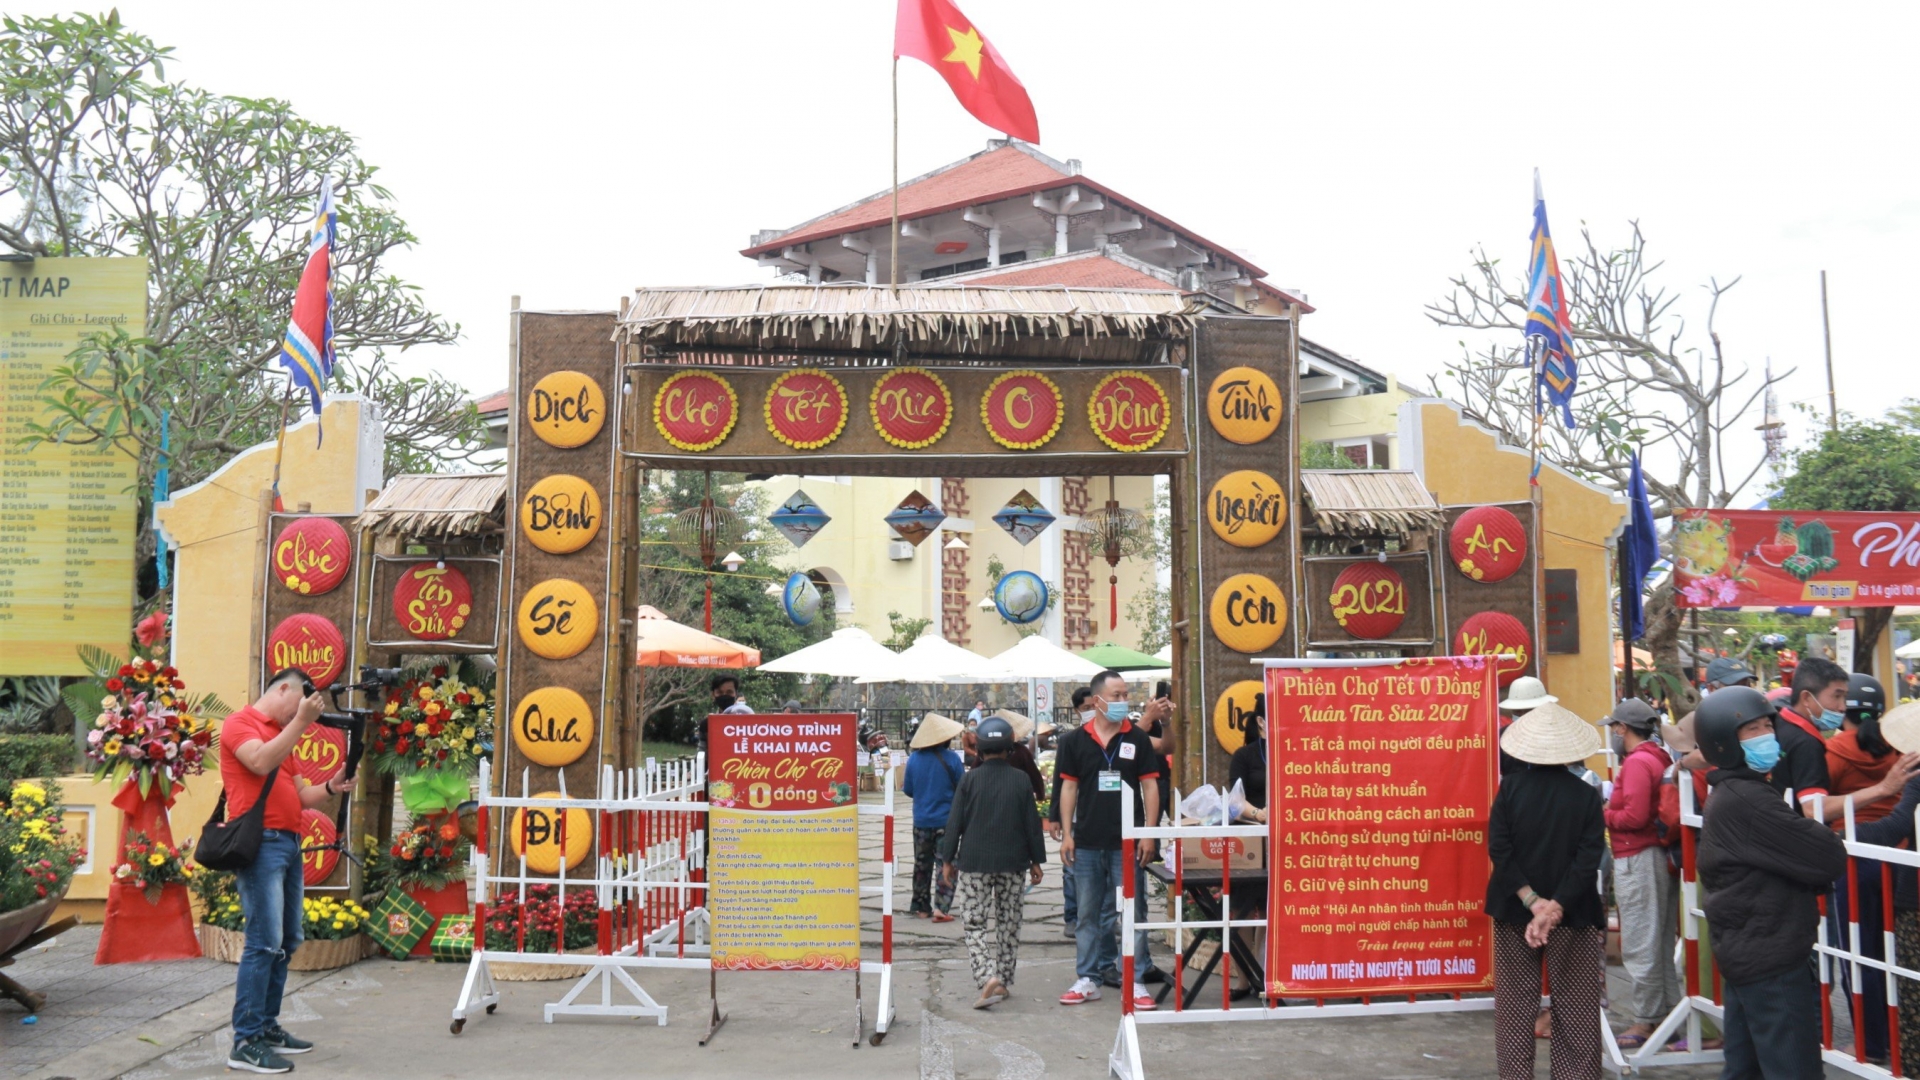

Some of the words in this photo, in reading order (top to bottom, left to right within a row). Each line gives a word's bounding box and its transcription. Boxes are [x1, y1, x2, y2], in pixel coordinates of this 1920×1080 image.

[20, 278, 70, 297] MAP
[31, 314, 49, 324] Ghi
[1338, 579, 1405, 615] 2021
[1832, 586, 1850, 598] gian
[1870, 586, 1883, 595] 14
[1902, 585, 1914, 595] 00
[1282, 676, 1336, 695] Phiên
[1343, 676, 1379, 701] Chợ
[1383, 674, 1415, 695] Tết
[1420, 677, 1432, 695] 0
[1436, 672, 1481, 699] Đồng
[1299, 705, 1346, 722] Xuân
[1350, 704, 1384, 721] Tân
[1389, 704, 1425, 722] Sửu
[1428, 704, 1468, 721] 2021
[724, 724, 793, 736] CHƯƠNG
[797, 722, 841, 735] TRÌNH
[734, 738, 748, 753] LỄ
[754, 742, 789, 753] KHAI
[795, 742, 831, 755] MẠC
[1285, 738, 1296, 751] 1.
[1301, 736, 1324, 750] Tất
[1328, 736, 1344, 750] cả
[1349, 737, 1375, 752] mọi
[1380, 737, 1421, 753] người
[1426, 735, 1452, 749] đều
[1457, 734, 1485, 752] phải
[722, 758, 770, 779] Phiên
[775, 758, 808, 781] Chợ
[811, 757, 843, 778] Tết
[1285, 762, 1312, 774] đeo
[1315, 757, 1349, 774] khẩu
[1352, 761, 1391, 776] trang
[749, 783, 771, 808] 0
[774, 785, 817, 803] đồng
[1285, 786, 1297, 798] 2.
[1301, 783, 1328, 797] Rửa
[1331, 785, 1352, 800] tay
[1356, 784, 1378, 797] sát
[1382, 780, 1426, 796] khuẩn
[1285, 809, 1297, 822] 3.
[1301, 808, 1326, 821] Giữ
[1328, 806, 1382, 823] khoảng
[1386, 806, 1420, 820] cách
[1424, 809, 1440, 819] an
[1443, 805, 1474, 818] toàn
[1285, 833, 1296, 845] 4.
[1301, 831, 1348, 847] Không
[1352, 829, 1370, 844] sử
[1372, 831, 1409, 846] dụng
[1413, 829, 1430, 843] túi
[1434, 828, 1482, 844] ni-lông
[1285, 856, 1296, 869] 5.
[1300, 855, 1326, 868] Giữ
[1328, 855, 1352, 870] trật
[1355, 855, 1371, 869] tự
[1373, 854, 1419, 869] chung
[1284, 880, 1296, 892] 6.
[1300, 878, 1326, 892] Giữ
[1328, 878, 1345, 894] vệ
[1348, 877, 1379, 891] sinh
[1383, 877, 1428, 892] chung
[1285, 905, 1295, 915] Vì
[1299, 905, 1320, 916] một
[1351, 904, 1365, 913] An
[1369, 903, 1397, 913] nhân
[1401, 903, 1421, 913] tình
[1424, 900, 1454, 911] thuần
[1301, 924, 1332, 934] mong
[1336, 922, 1355, 933] mọi
[1359, 921, 1390, 933] người
[1394, 918, 1419, 931] chấp
[1423, 919, 1449, 928] hành
[1453, 917, 1467, 928] tốt
[1292, 961, 1327, 980] NHÓM
[1331, 960, 1363, 982] THIỆN
[1367, 958, 1412, 980] NGUYỆN
[1416, 958, 1440, 976] TƯƠI
[1444, 956, 1475, 975] SÁNG
